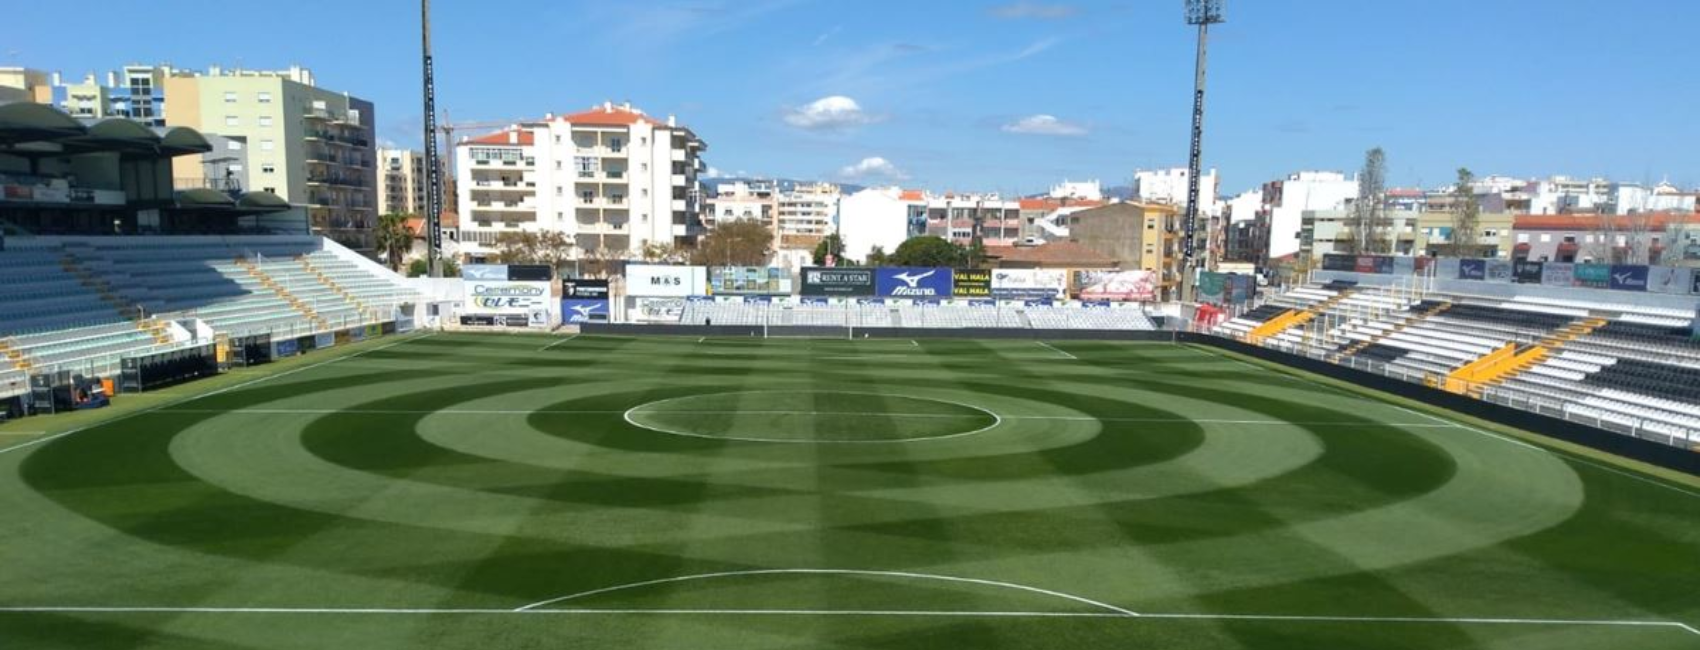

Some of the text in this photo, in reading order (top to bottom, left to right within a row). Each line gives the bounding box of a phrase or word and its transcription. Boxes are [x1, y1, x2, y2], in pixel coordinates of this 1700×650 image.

[651, 276, 661, 285] M
[674, 277, 681, 285] S
[474, 284, 545, 296] Ceremony
